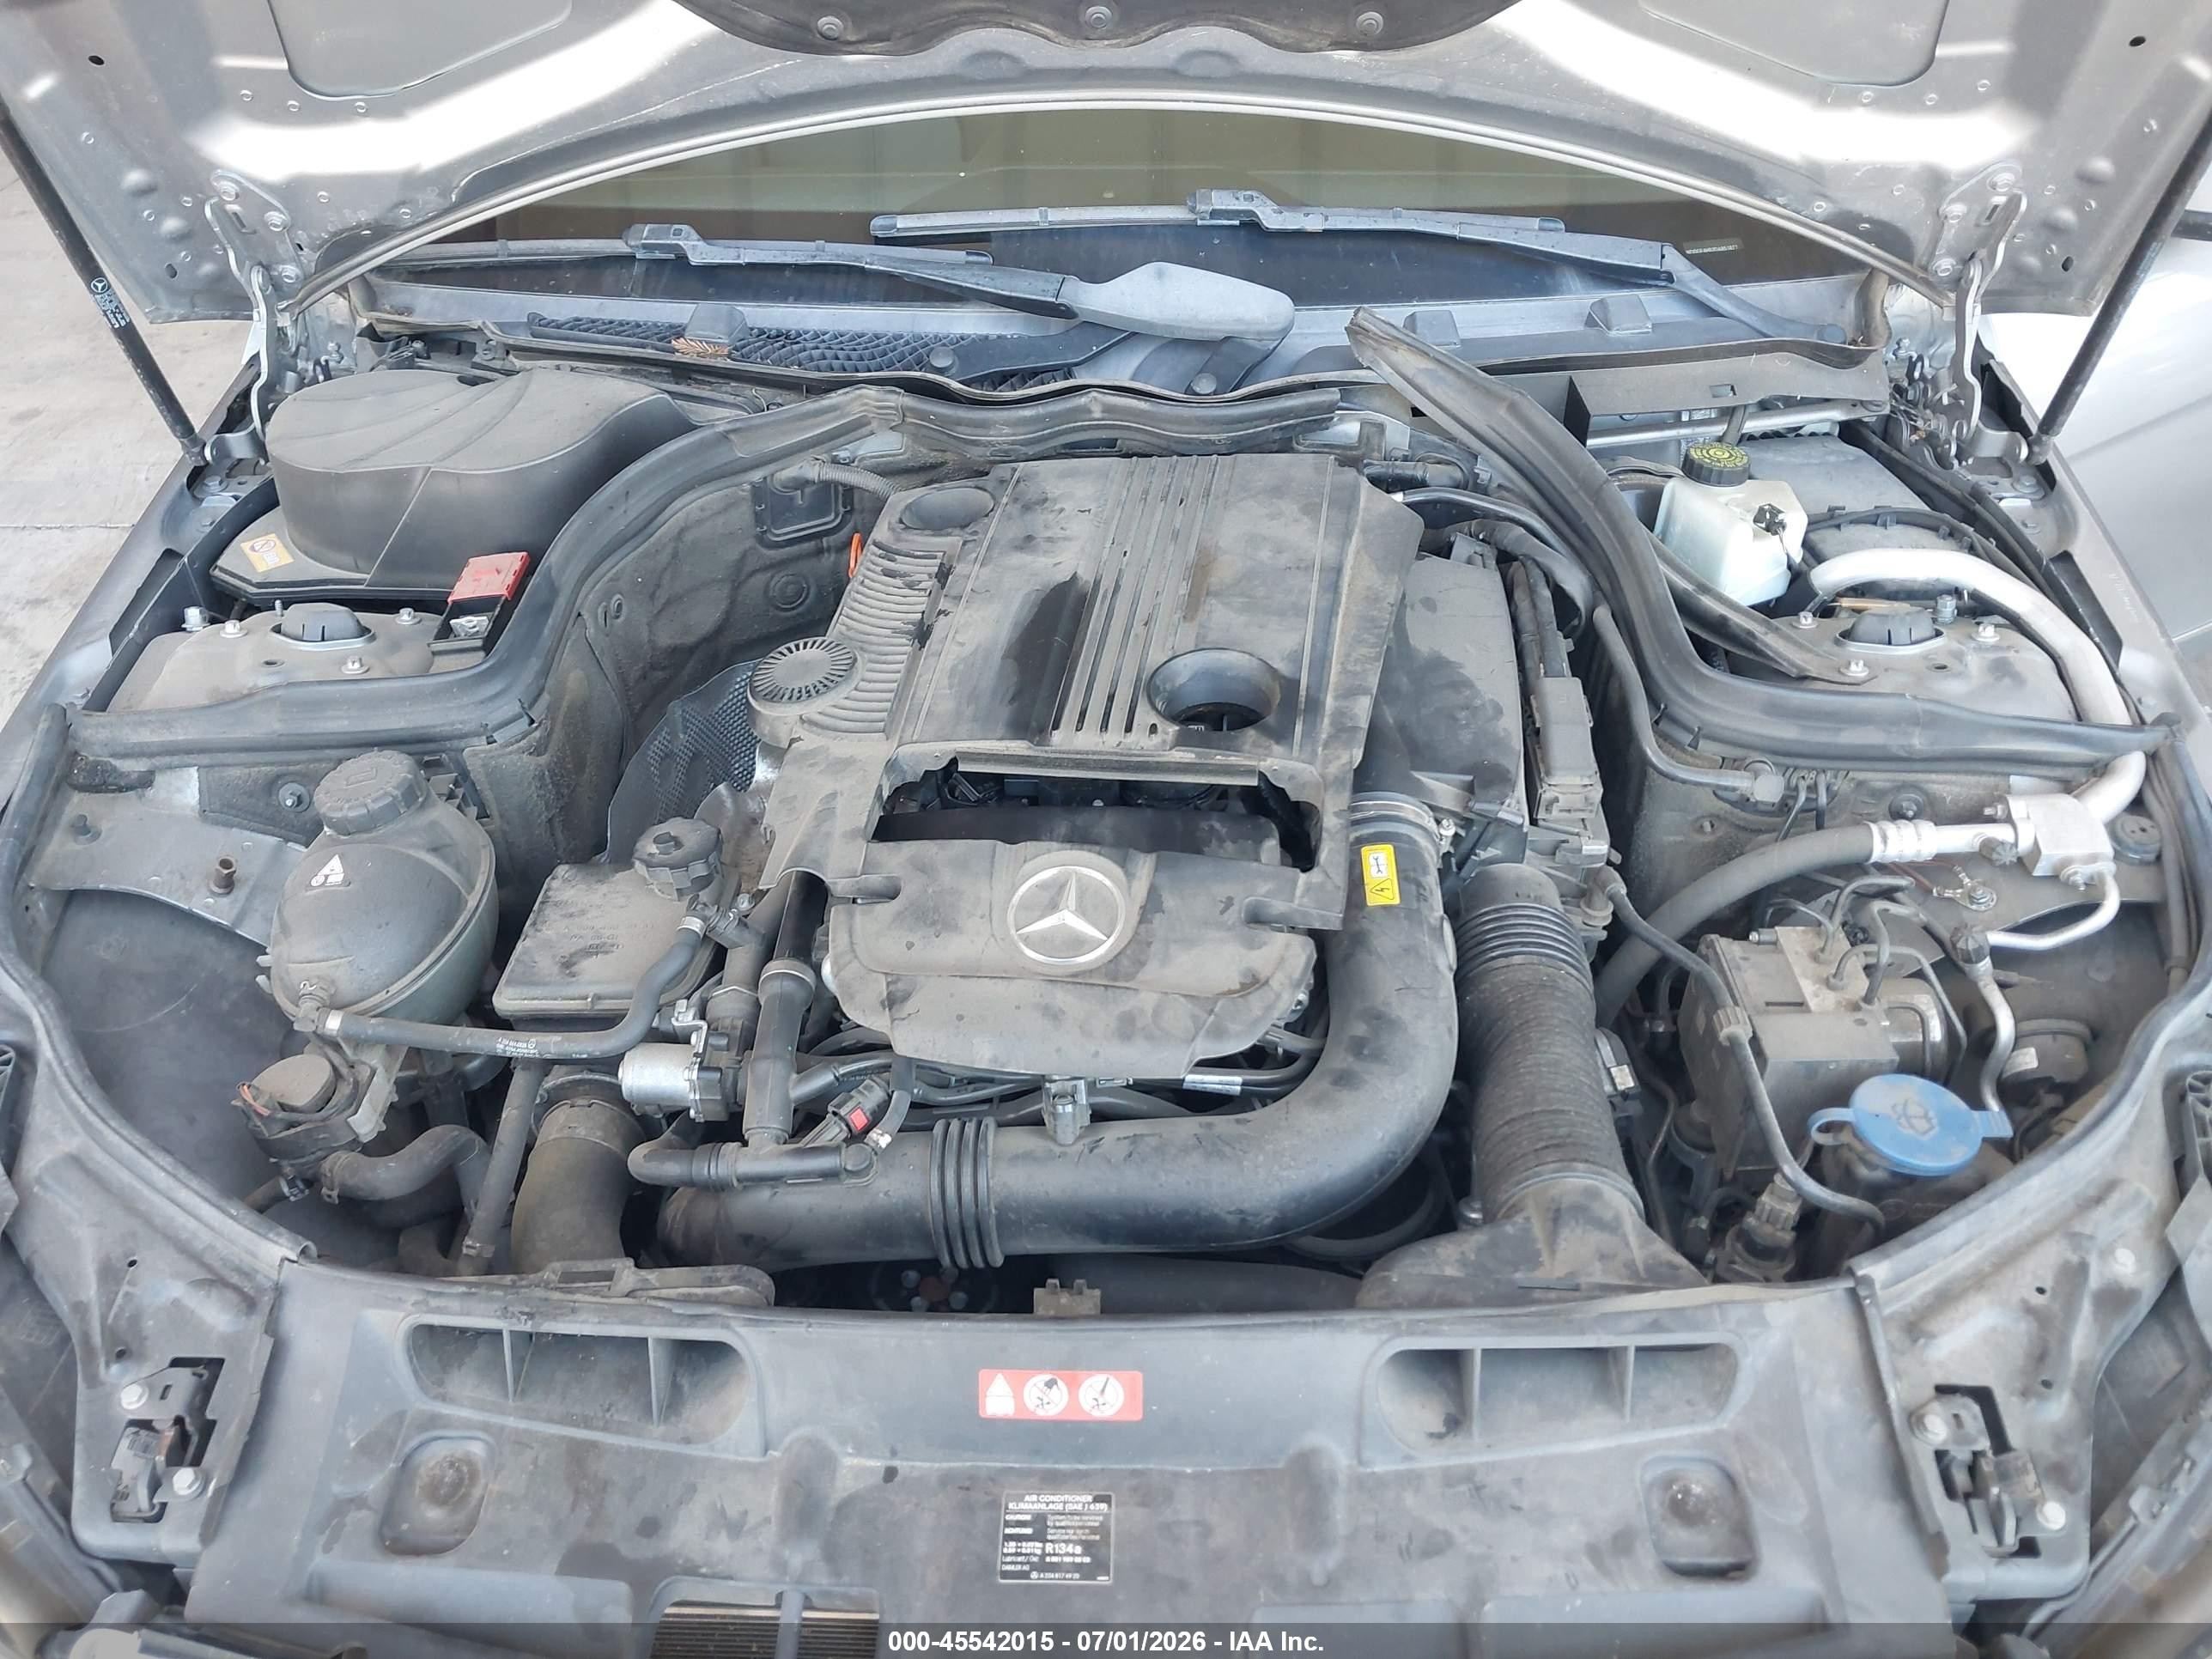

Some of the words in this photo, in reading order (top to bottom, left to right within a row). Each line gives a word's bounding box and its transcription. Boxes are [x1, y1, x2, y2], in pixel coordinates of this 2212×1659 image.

[1008, 1502, 1064, 1510] KLIMAANLAGE
[1065, 1503, 1083, 1511] (SAE
[1045, 1542, 1082, 1554] R134a
